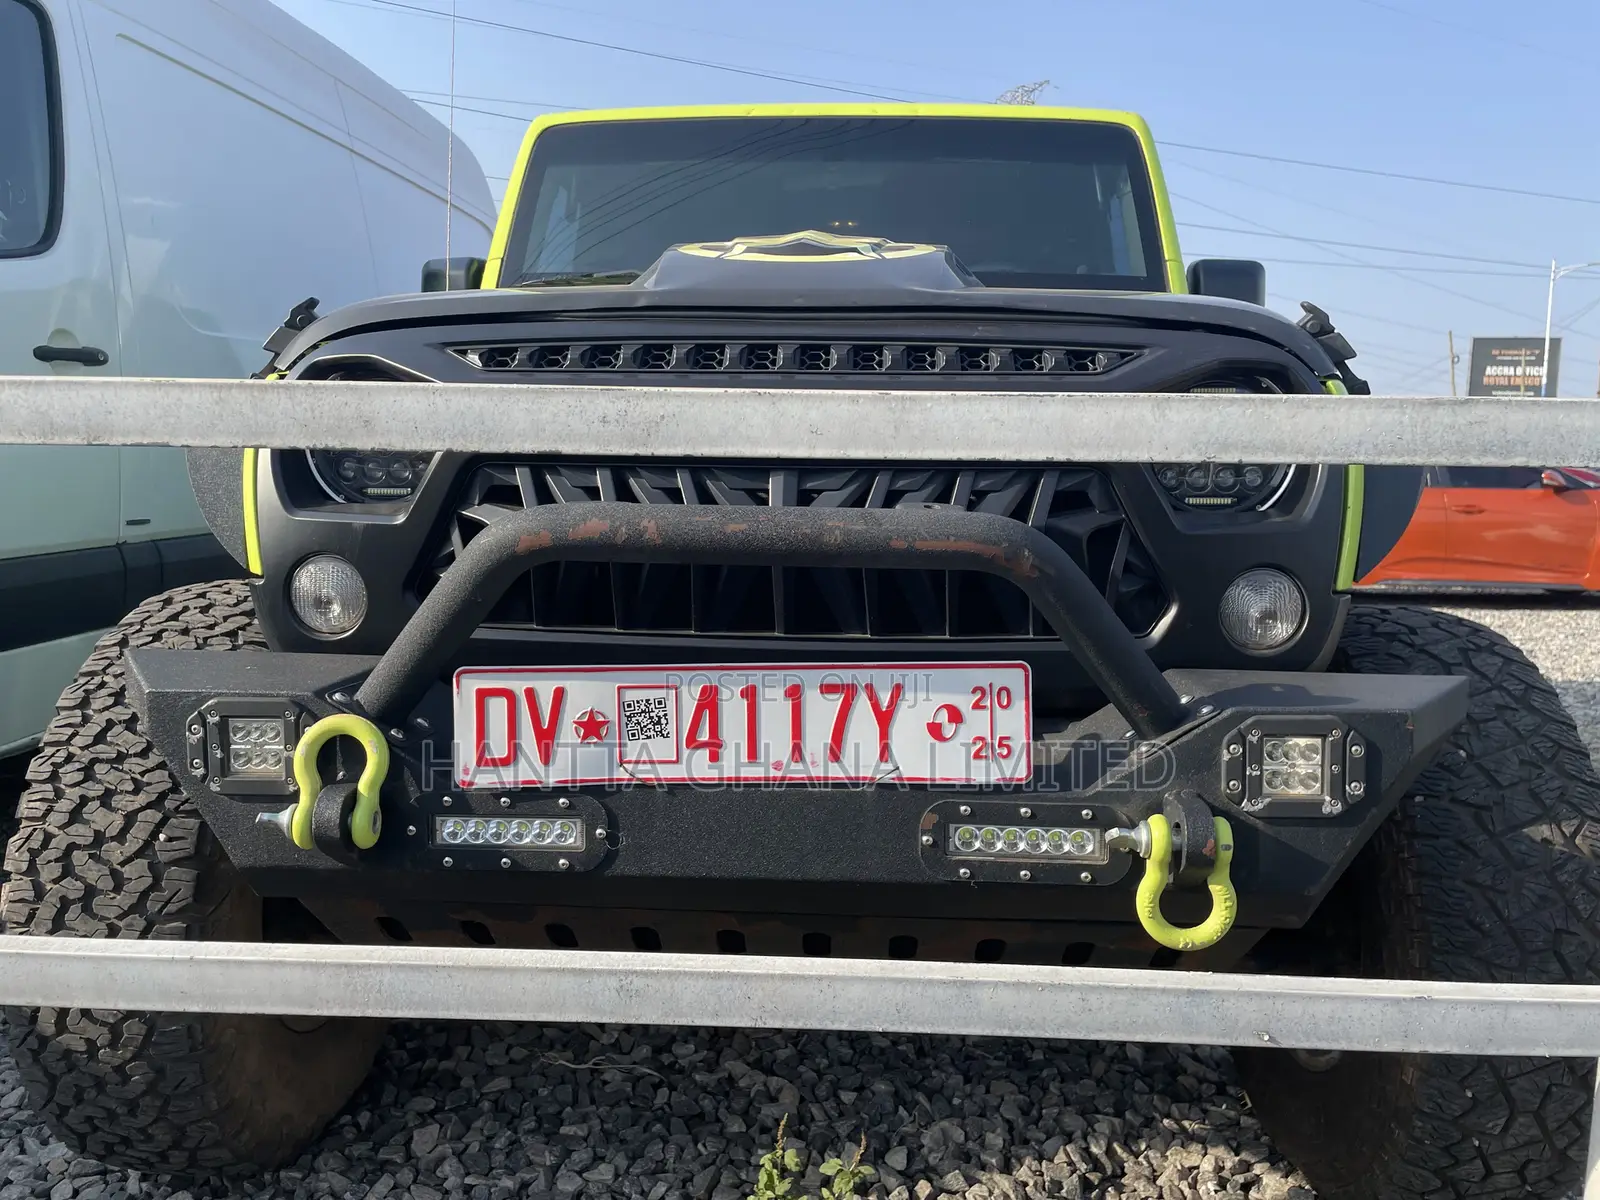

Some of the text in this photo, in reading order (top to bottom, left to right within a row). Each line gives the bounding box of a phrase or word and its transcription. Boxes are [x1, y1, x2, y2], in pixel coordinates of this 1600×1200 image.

[1485, 365, 1515, 377] ACCRA
[970, 684, 1013, 711] 20
[474, 682, 904, 768] DV 4117Y
[971, 735, 1013, 761] 25
